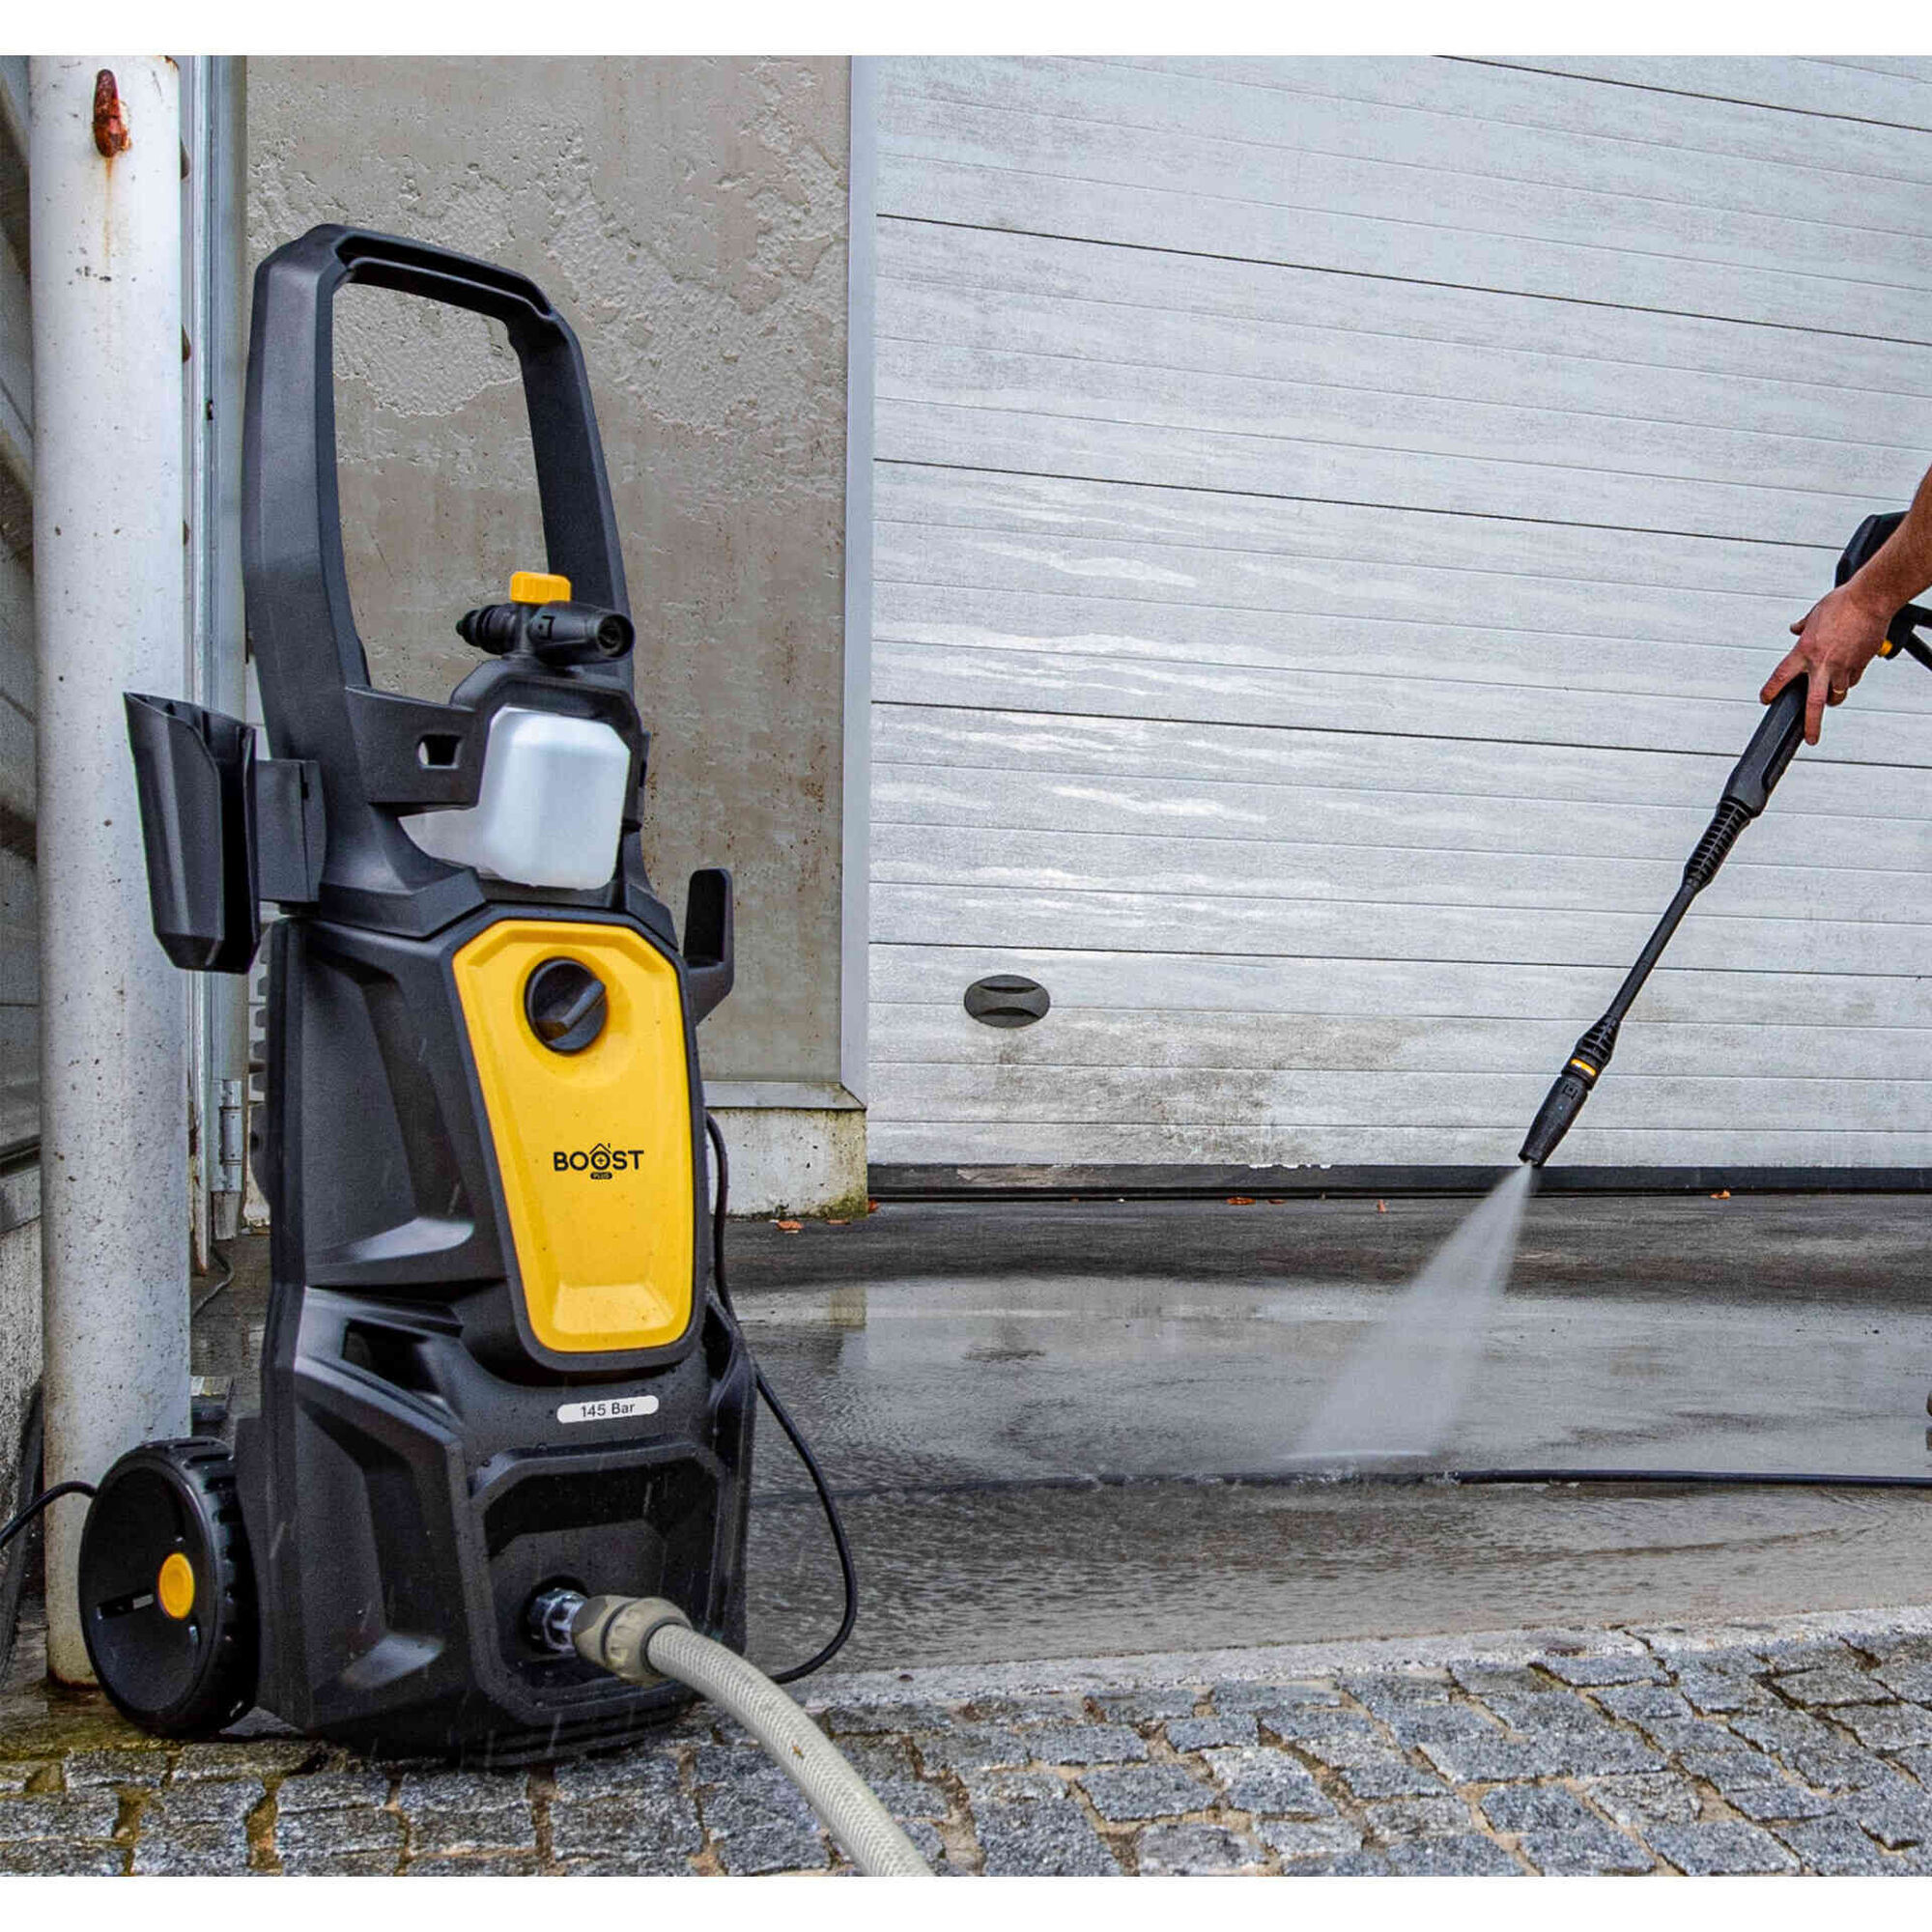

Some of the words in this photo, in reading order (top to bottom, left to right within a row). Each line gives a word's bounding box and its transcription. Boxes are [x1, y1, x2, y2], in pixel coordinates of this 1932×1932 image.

[553, 1149, 645, 1172] BOOST
[580, 1403, 607, 1418] 145
[611, 1401, 636, 1415] Bar
